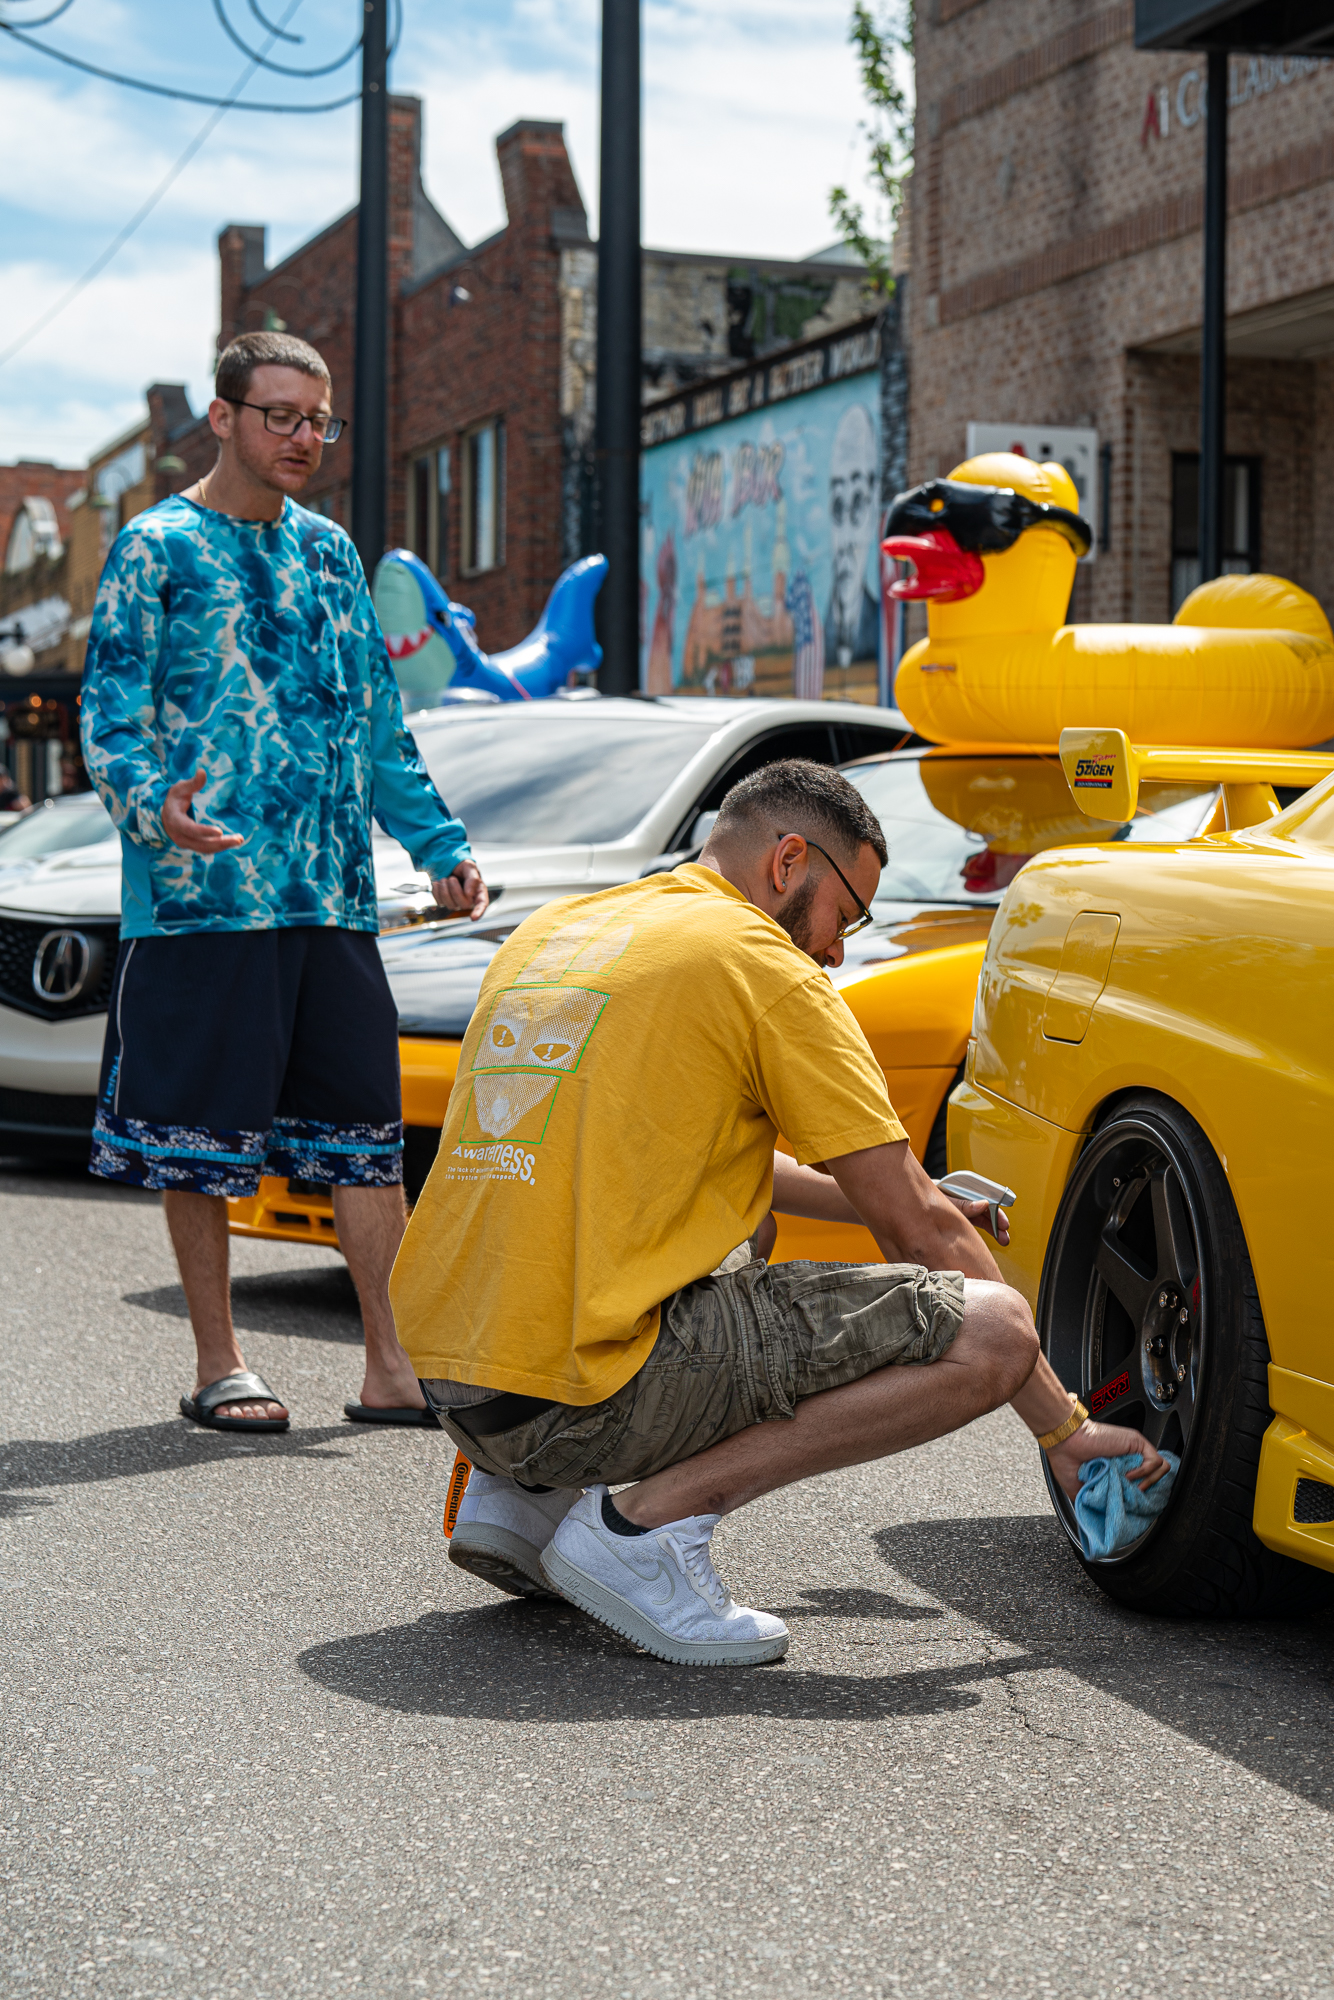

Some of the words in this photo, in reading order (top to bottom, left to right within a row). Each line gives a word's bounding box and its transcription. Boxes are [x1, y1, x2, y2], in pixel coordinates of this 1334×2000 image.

[451, 1144, 536, 1186] Awareness.
[1091, 1378, 1130, 1414] RAYS
[447, 1462, 469, 1523] Continental
